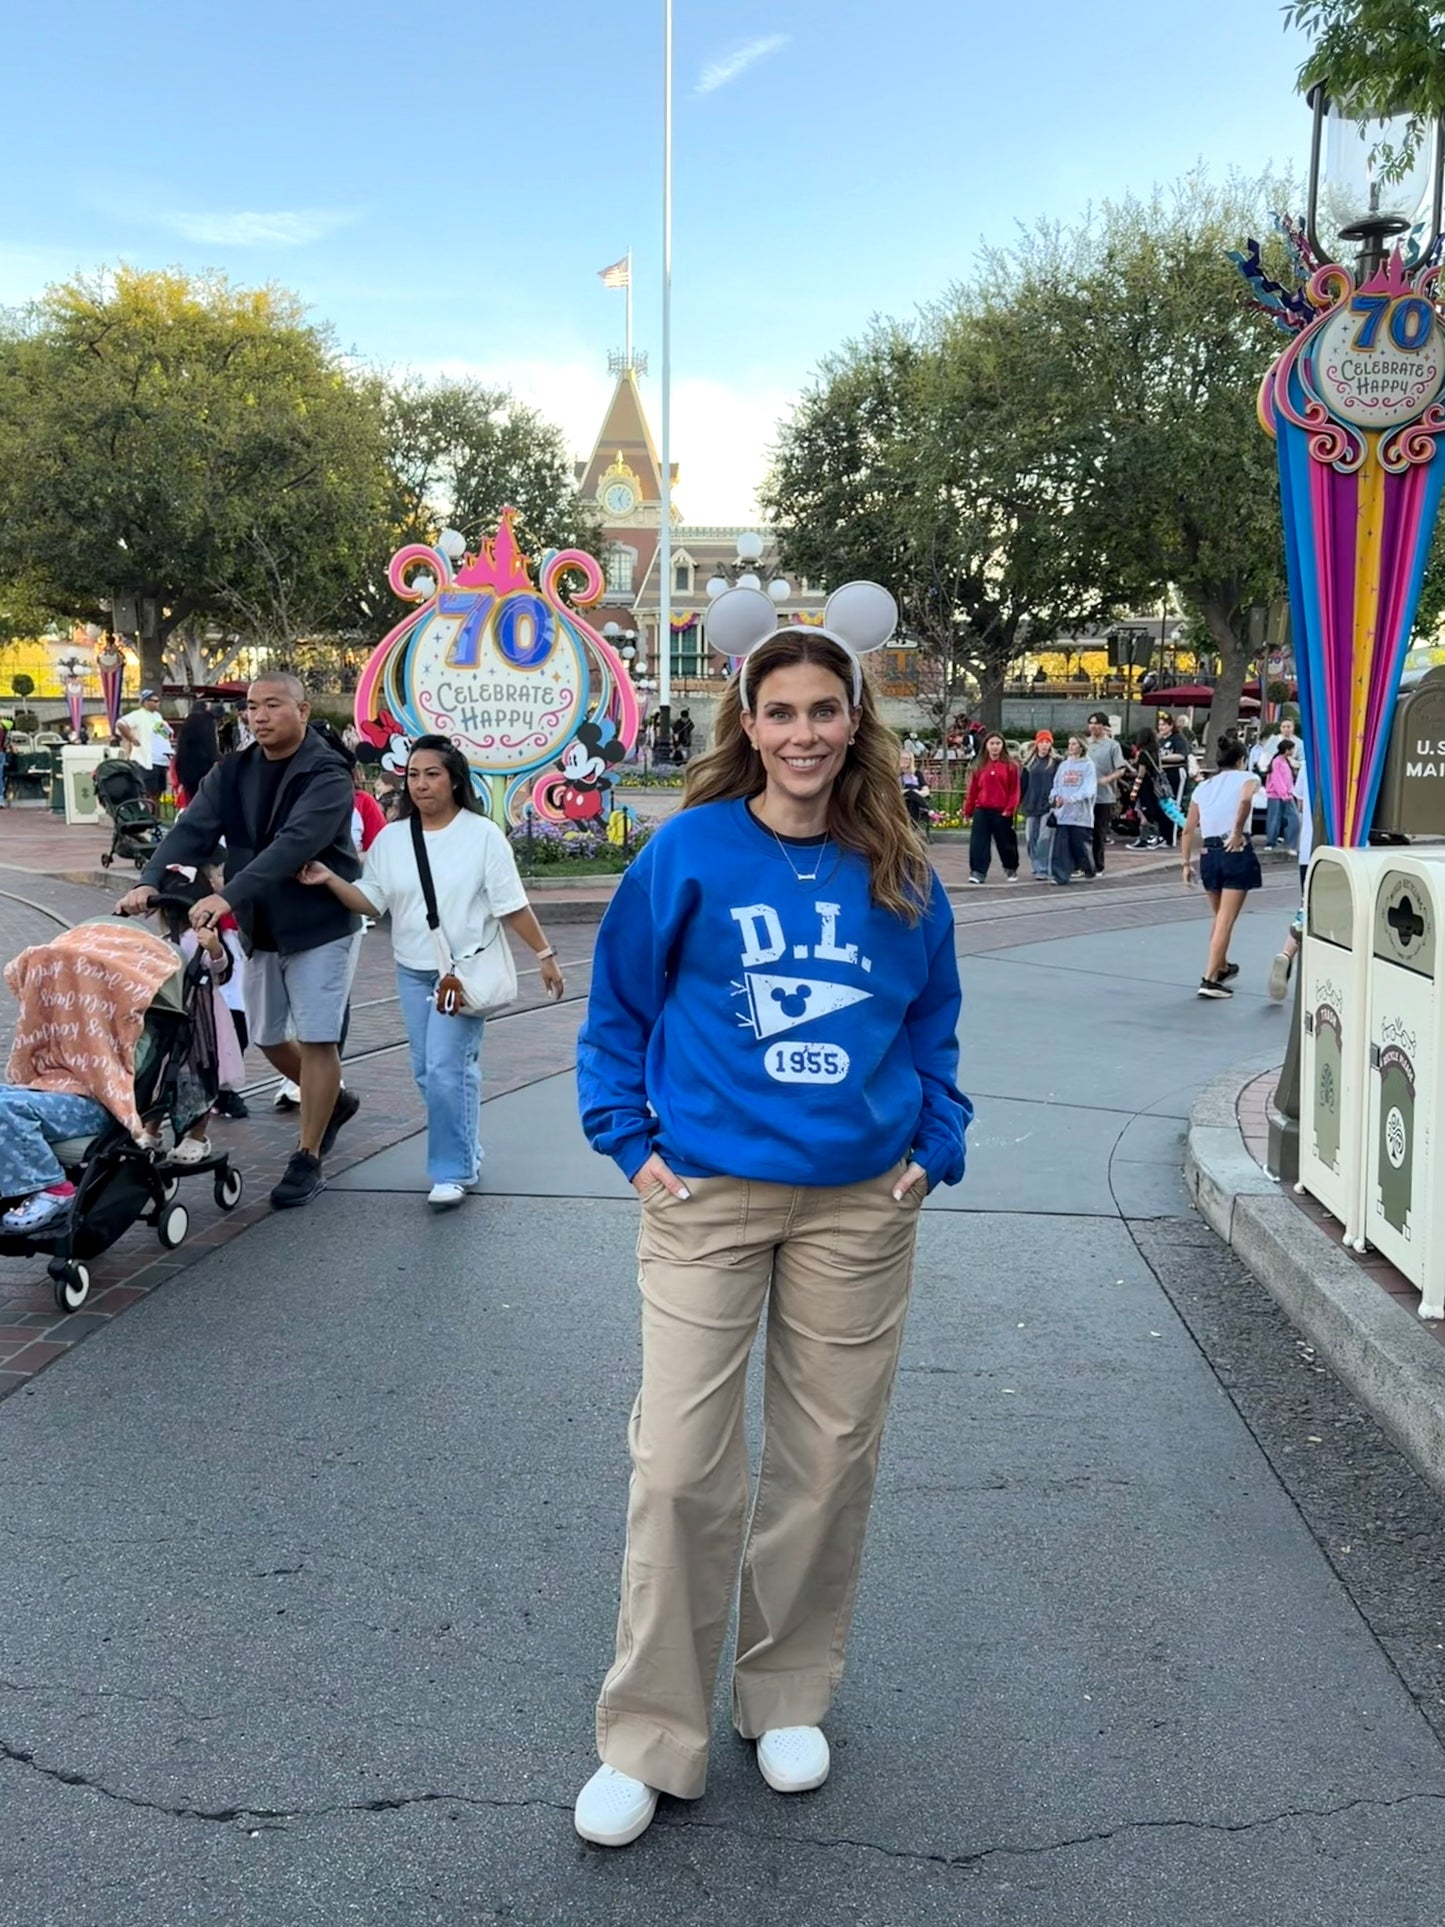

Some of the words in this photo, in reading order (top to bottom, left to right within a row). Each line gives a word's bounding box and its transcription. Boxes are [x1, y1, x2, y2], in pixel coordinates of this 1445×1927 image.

[1350, 295, 1435, 351] 70
[1341, 360, 1424, 381] CELEBRATE
[1356, 376, 1409, 396] HAPPY
[438, 591, 556, 671] 70
[437, 682, 555, 712] CELEBRATE
[460, 706, 534, 733] HAPPY
[1416, 740, 1445, 755] U.S
[1406, 762, 1445, 777] MAI
[729, 901, 872, 973] D.L.
[775, 1050, 839, 1075] 1955
